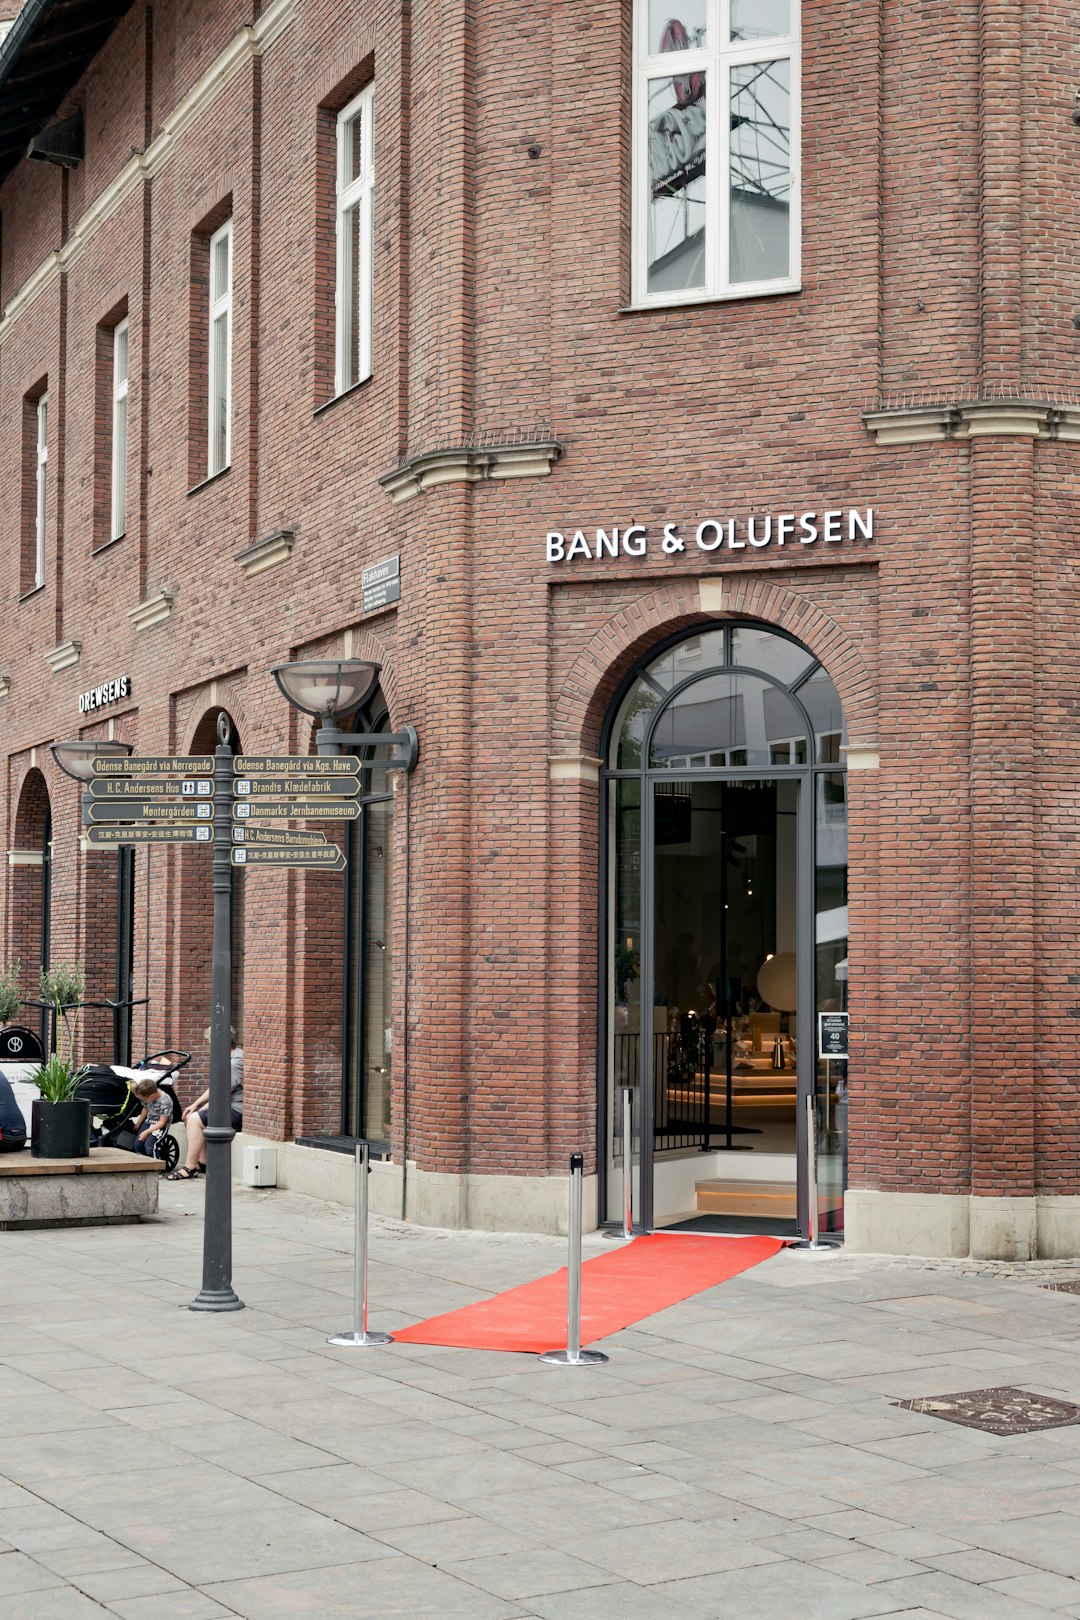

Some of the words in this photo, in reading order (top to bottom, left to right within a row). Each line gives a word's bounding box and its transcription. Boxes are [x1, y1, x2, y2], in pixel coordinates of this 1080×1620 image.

[545, 524, 648, 562] BANG
[661, 522, 685, 554] &
[695, 507, 874, 551] OLUFSEN
[79, 676, 128, 713] DREWSENS
[96, 760, 122, 771] Odense
[124, 760, 157, 773] Banegård
[160, 761, 170, 771] via
[172, 759, 211, 772] Nørregade
[237, 759, 264, 771] Odense
[266, 759, 300, 773] Banegård
[303, 761, 314, 771] via
[315, 760, 332, 773] Kgs.
[333, 760, 351, 771] Have
[107, 782, 114, 793] H.
[115, 782, 123, 793] C.
[124, 782, 164, 793] Andersens
[166, 782, 180, 793] Hus
[252, 781, 282, 793] Brandts
[284, 781, 331, 793] Klædefabrik
[143, 805, 195, 818] Møntergården
[250, 805, 288, 816] Danmarks
[289, 804, 355, 816] Jernbanemuseum
[244, 830, 255, 841] H.C.
[255, 830, 285, 844] Andersens
[830, 1032, 840, 1040] 40
